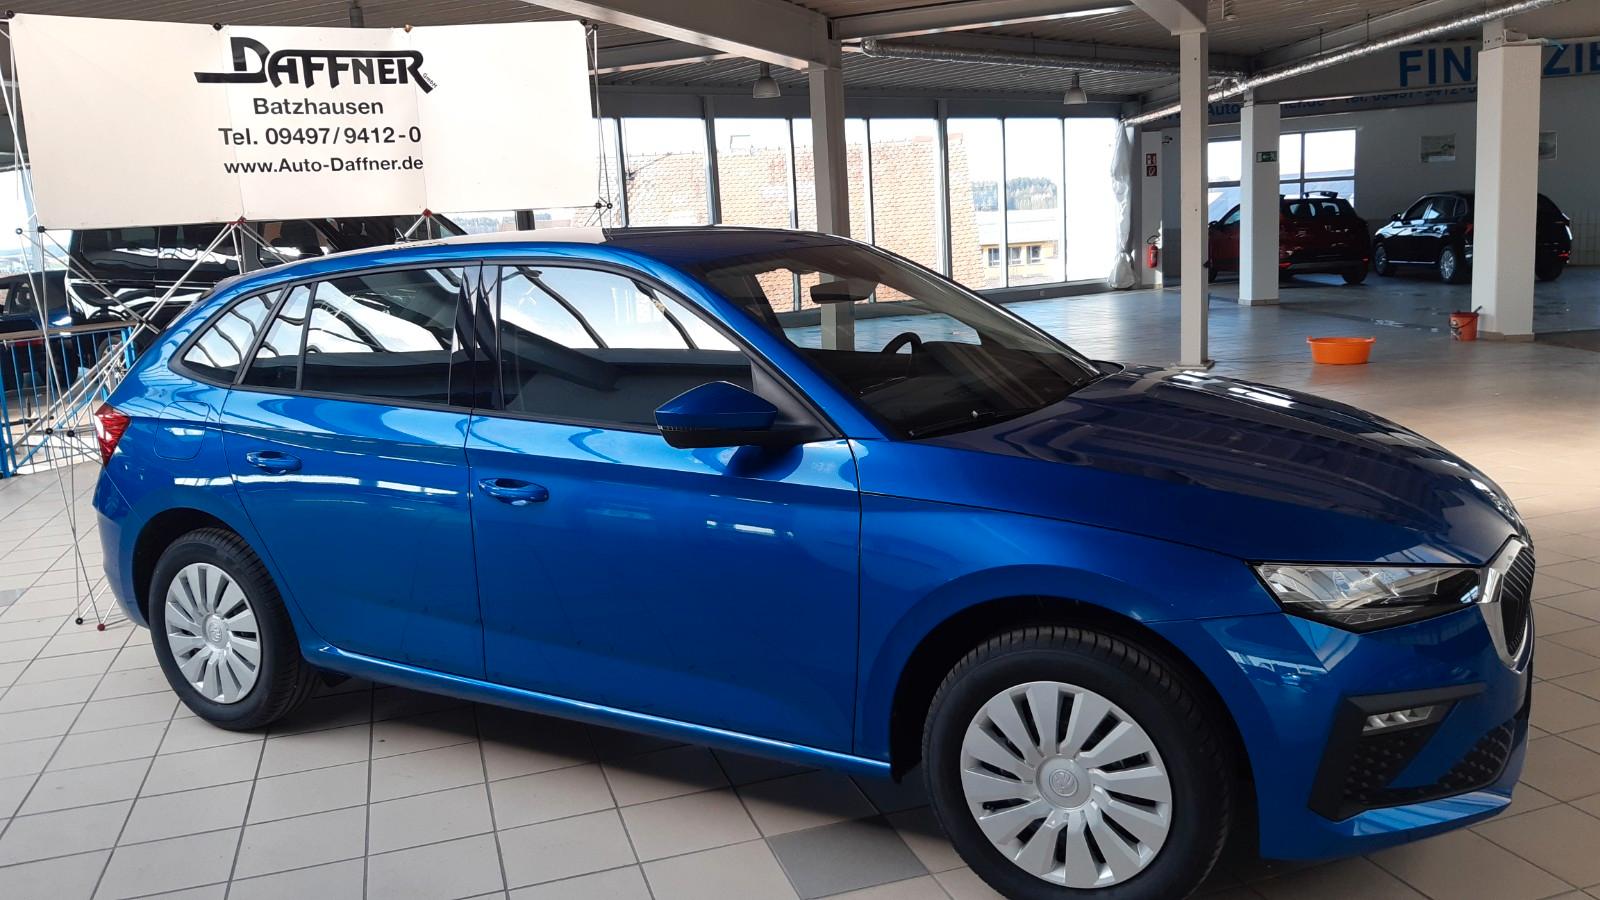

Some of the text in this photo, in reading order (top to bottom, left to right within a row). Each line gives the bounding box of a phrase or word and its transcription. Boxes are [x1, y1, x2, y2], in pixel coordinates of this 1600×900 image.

[194, 36, 433, 94] DAFFNER
[253, 97, 384, 115] Batzhausen
[218, 127, 258, 145] Tel.
[224, 156, 424, 174] www.Auto-Daffner.de
